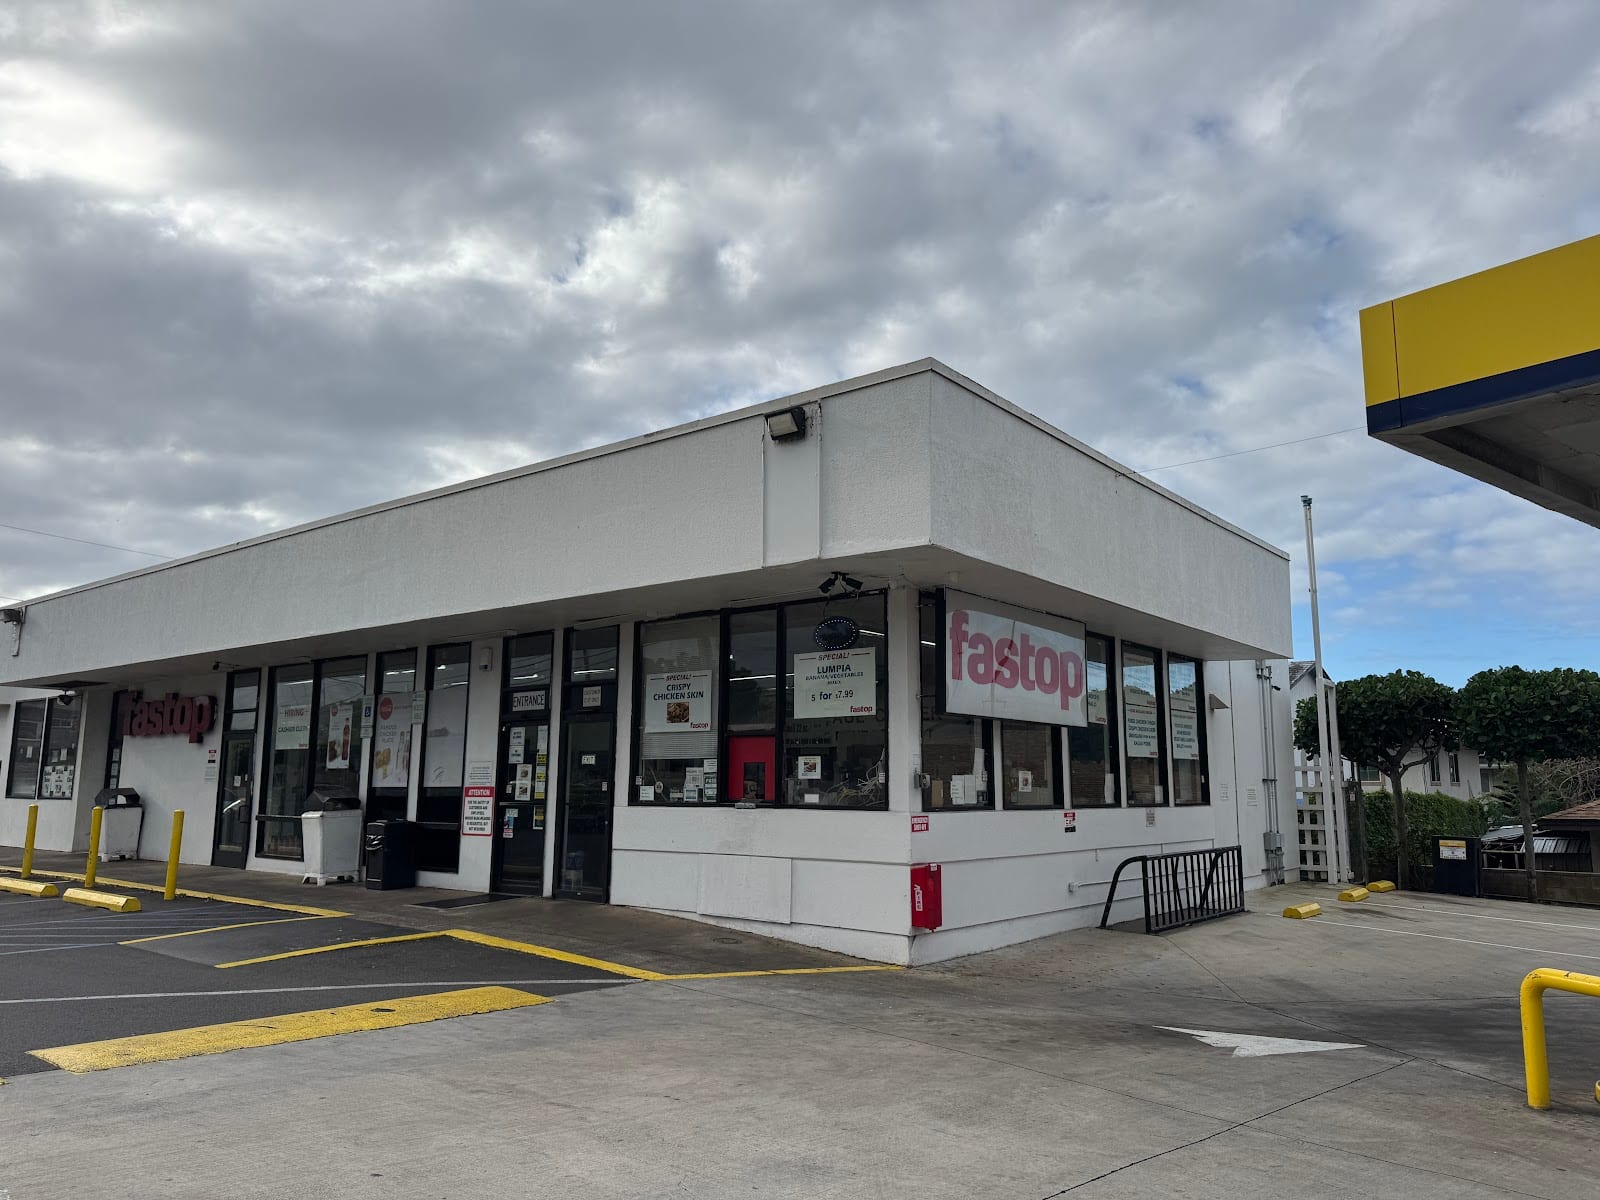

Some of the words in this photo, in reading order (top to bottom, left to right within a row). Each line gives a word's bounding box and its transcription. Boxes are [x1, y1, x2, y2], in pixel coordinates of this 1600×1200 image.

[817, 652, 850, 661] SPECIAL!
[949, 609, 1084, 711] fastop
[817, 664, 852, 674] LUMPIA
[665, 674, 692, 682] SPECIAL!
[666, 683, 691, 691] CRISPY
[512, 693, 545, 708] ENTRANCE
[653, 692, 686, 701] CHICKEN
[686, 691, 704, 699] SKIN
[811, 694, 816, 702] 5
[819, 691, 832, 701] for
[850, 705, 873, 713] fastop
[582, 756, 595, 764] EXIT
